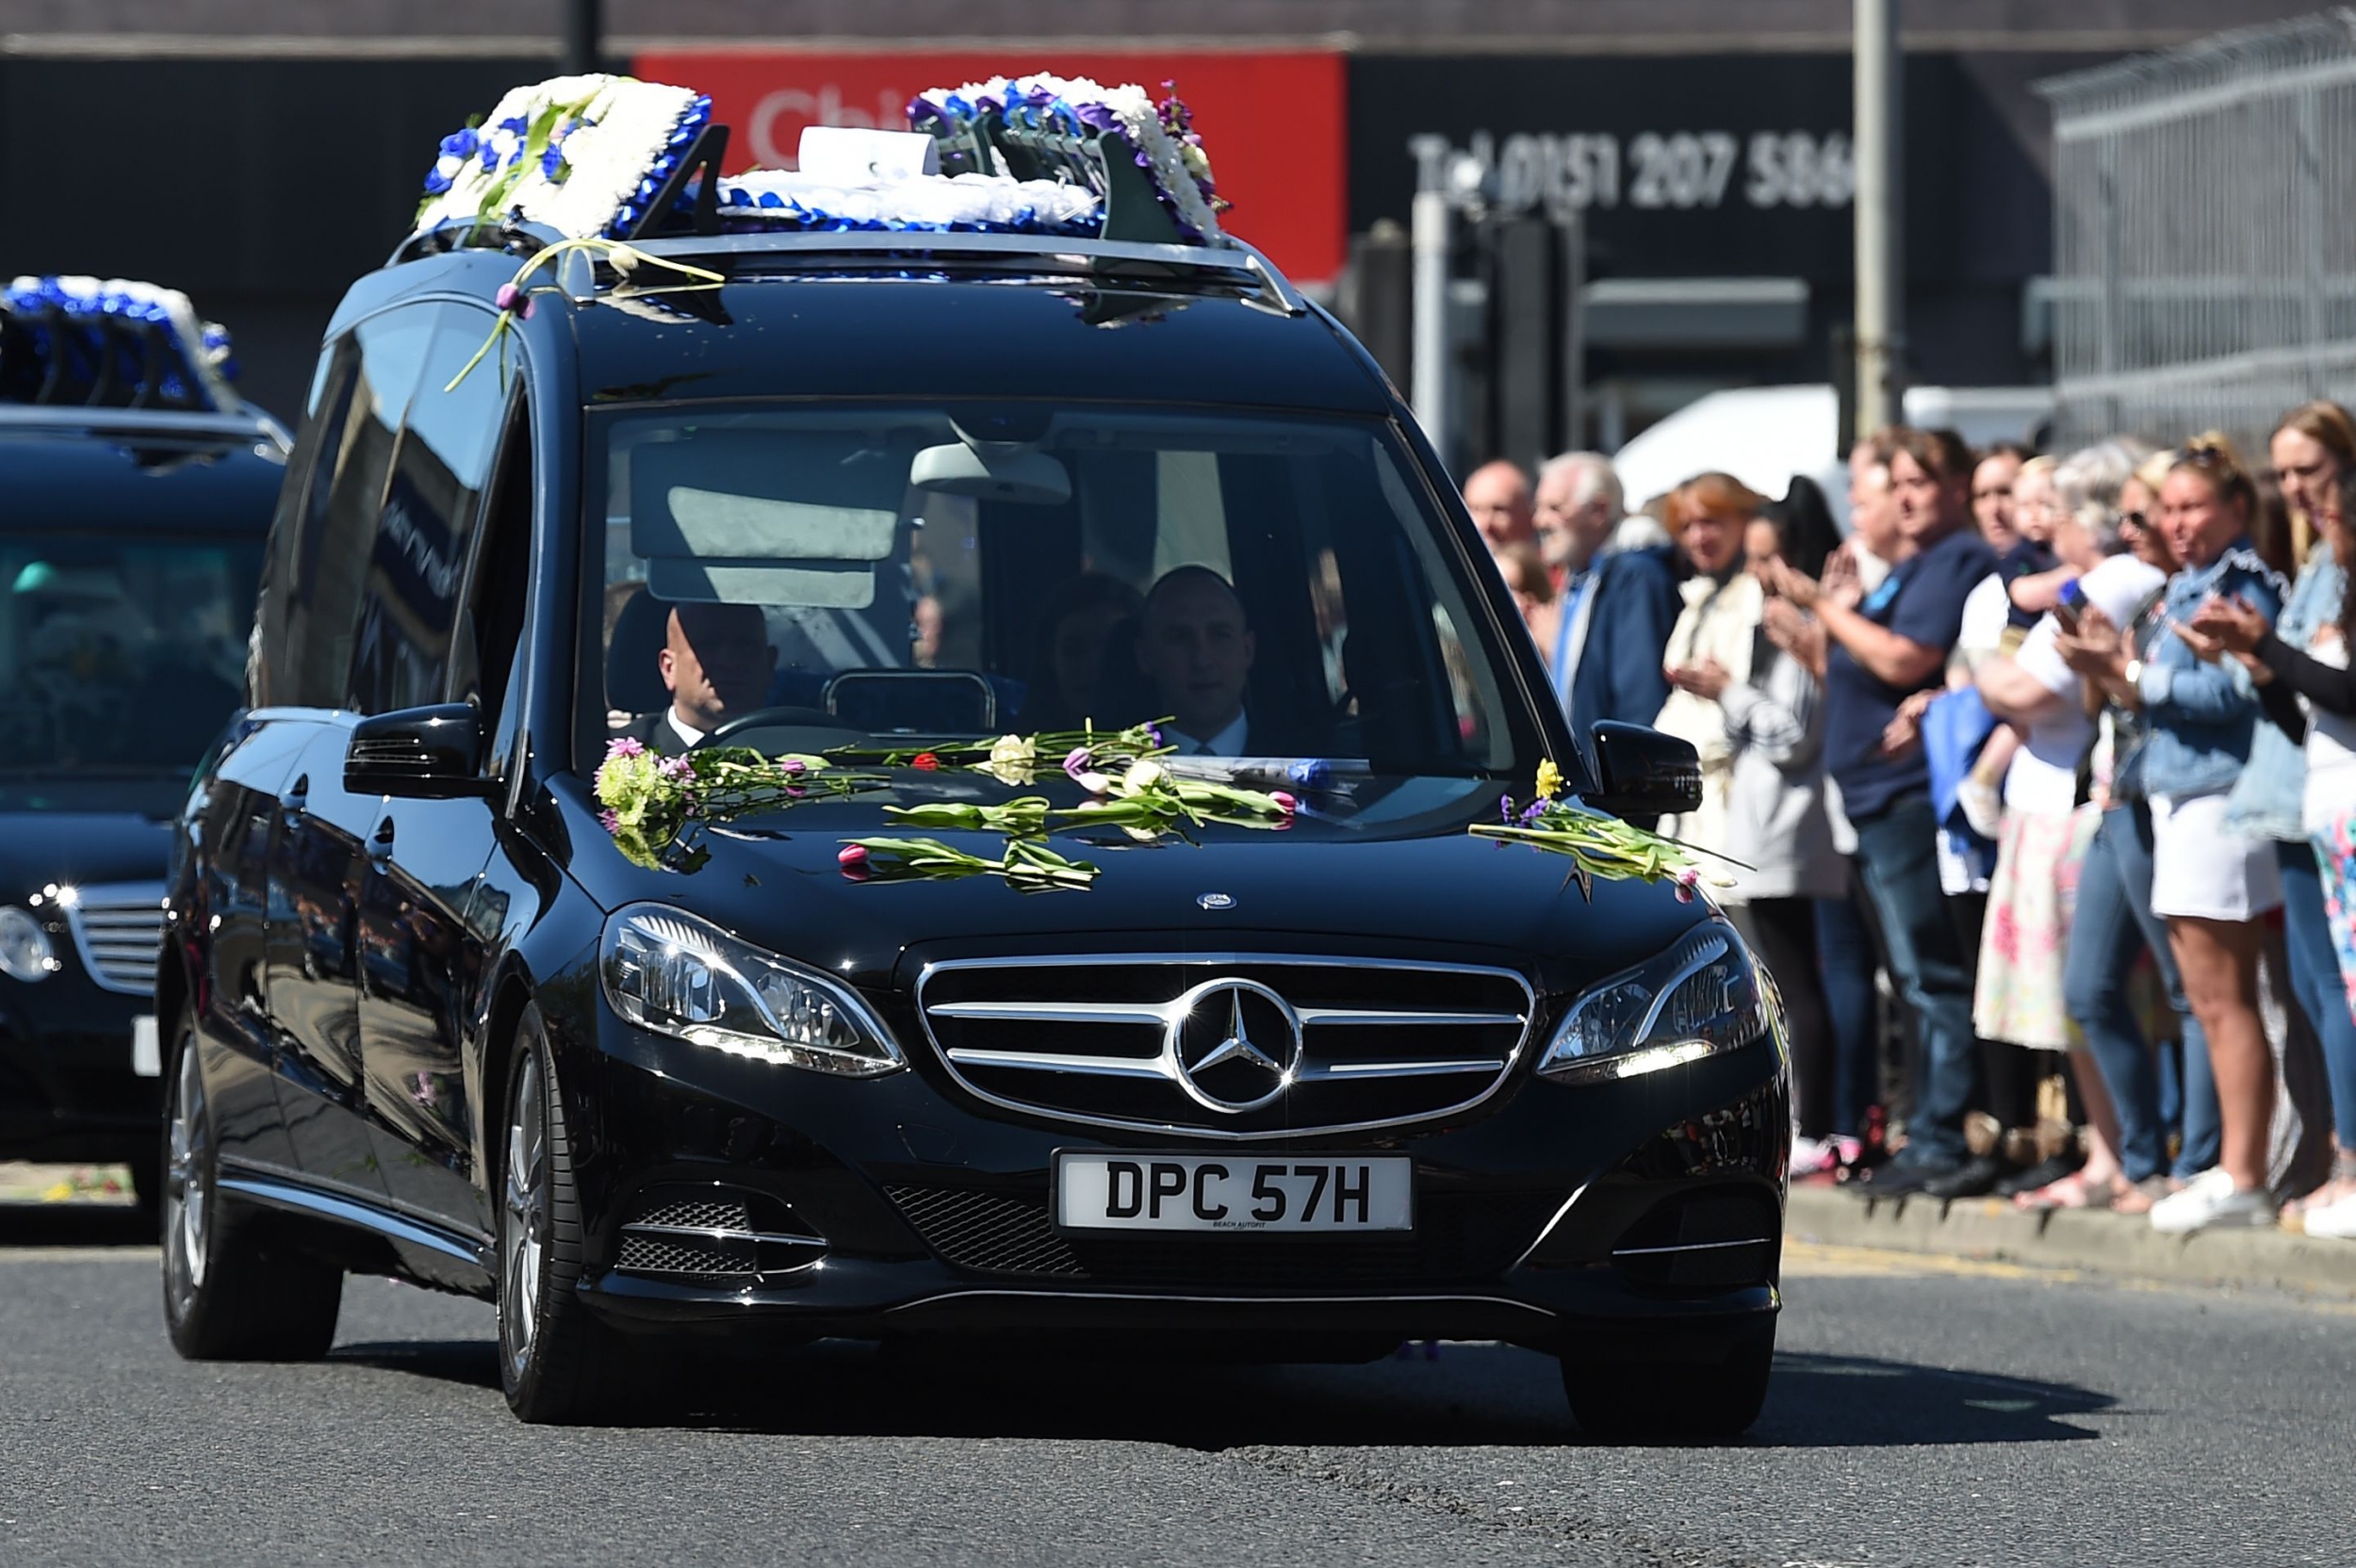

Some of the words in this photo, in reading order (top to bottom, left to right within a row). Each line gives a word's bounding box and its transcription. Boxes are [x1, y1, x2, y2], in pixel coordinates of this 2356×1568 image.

[1500, 133, 1620, 208] 0151
[1628, 132, 1738, 208] 207
[1106, 1162, 1229, 1220] DPC
[1252, 1165, 1369, 1222] 57H
